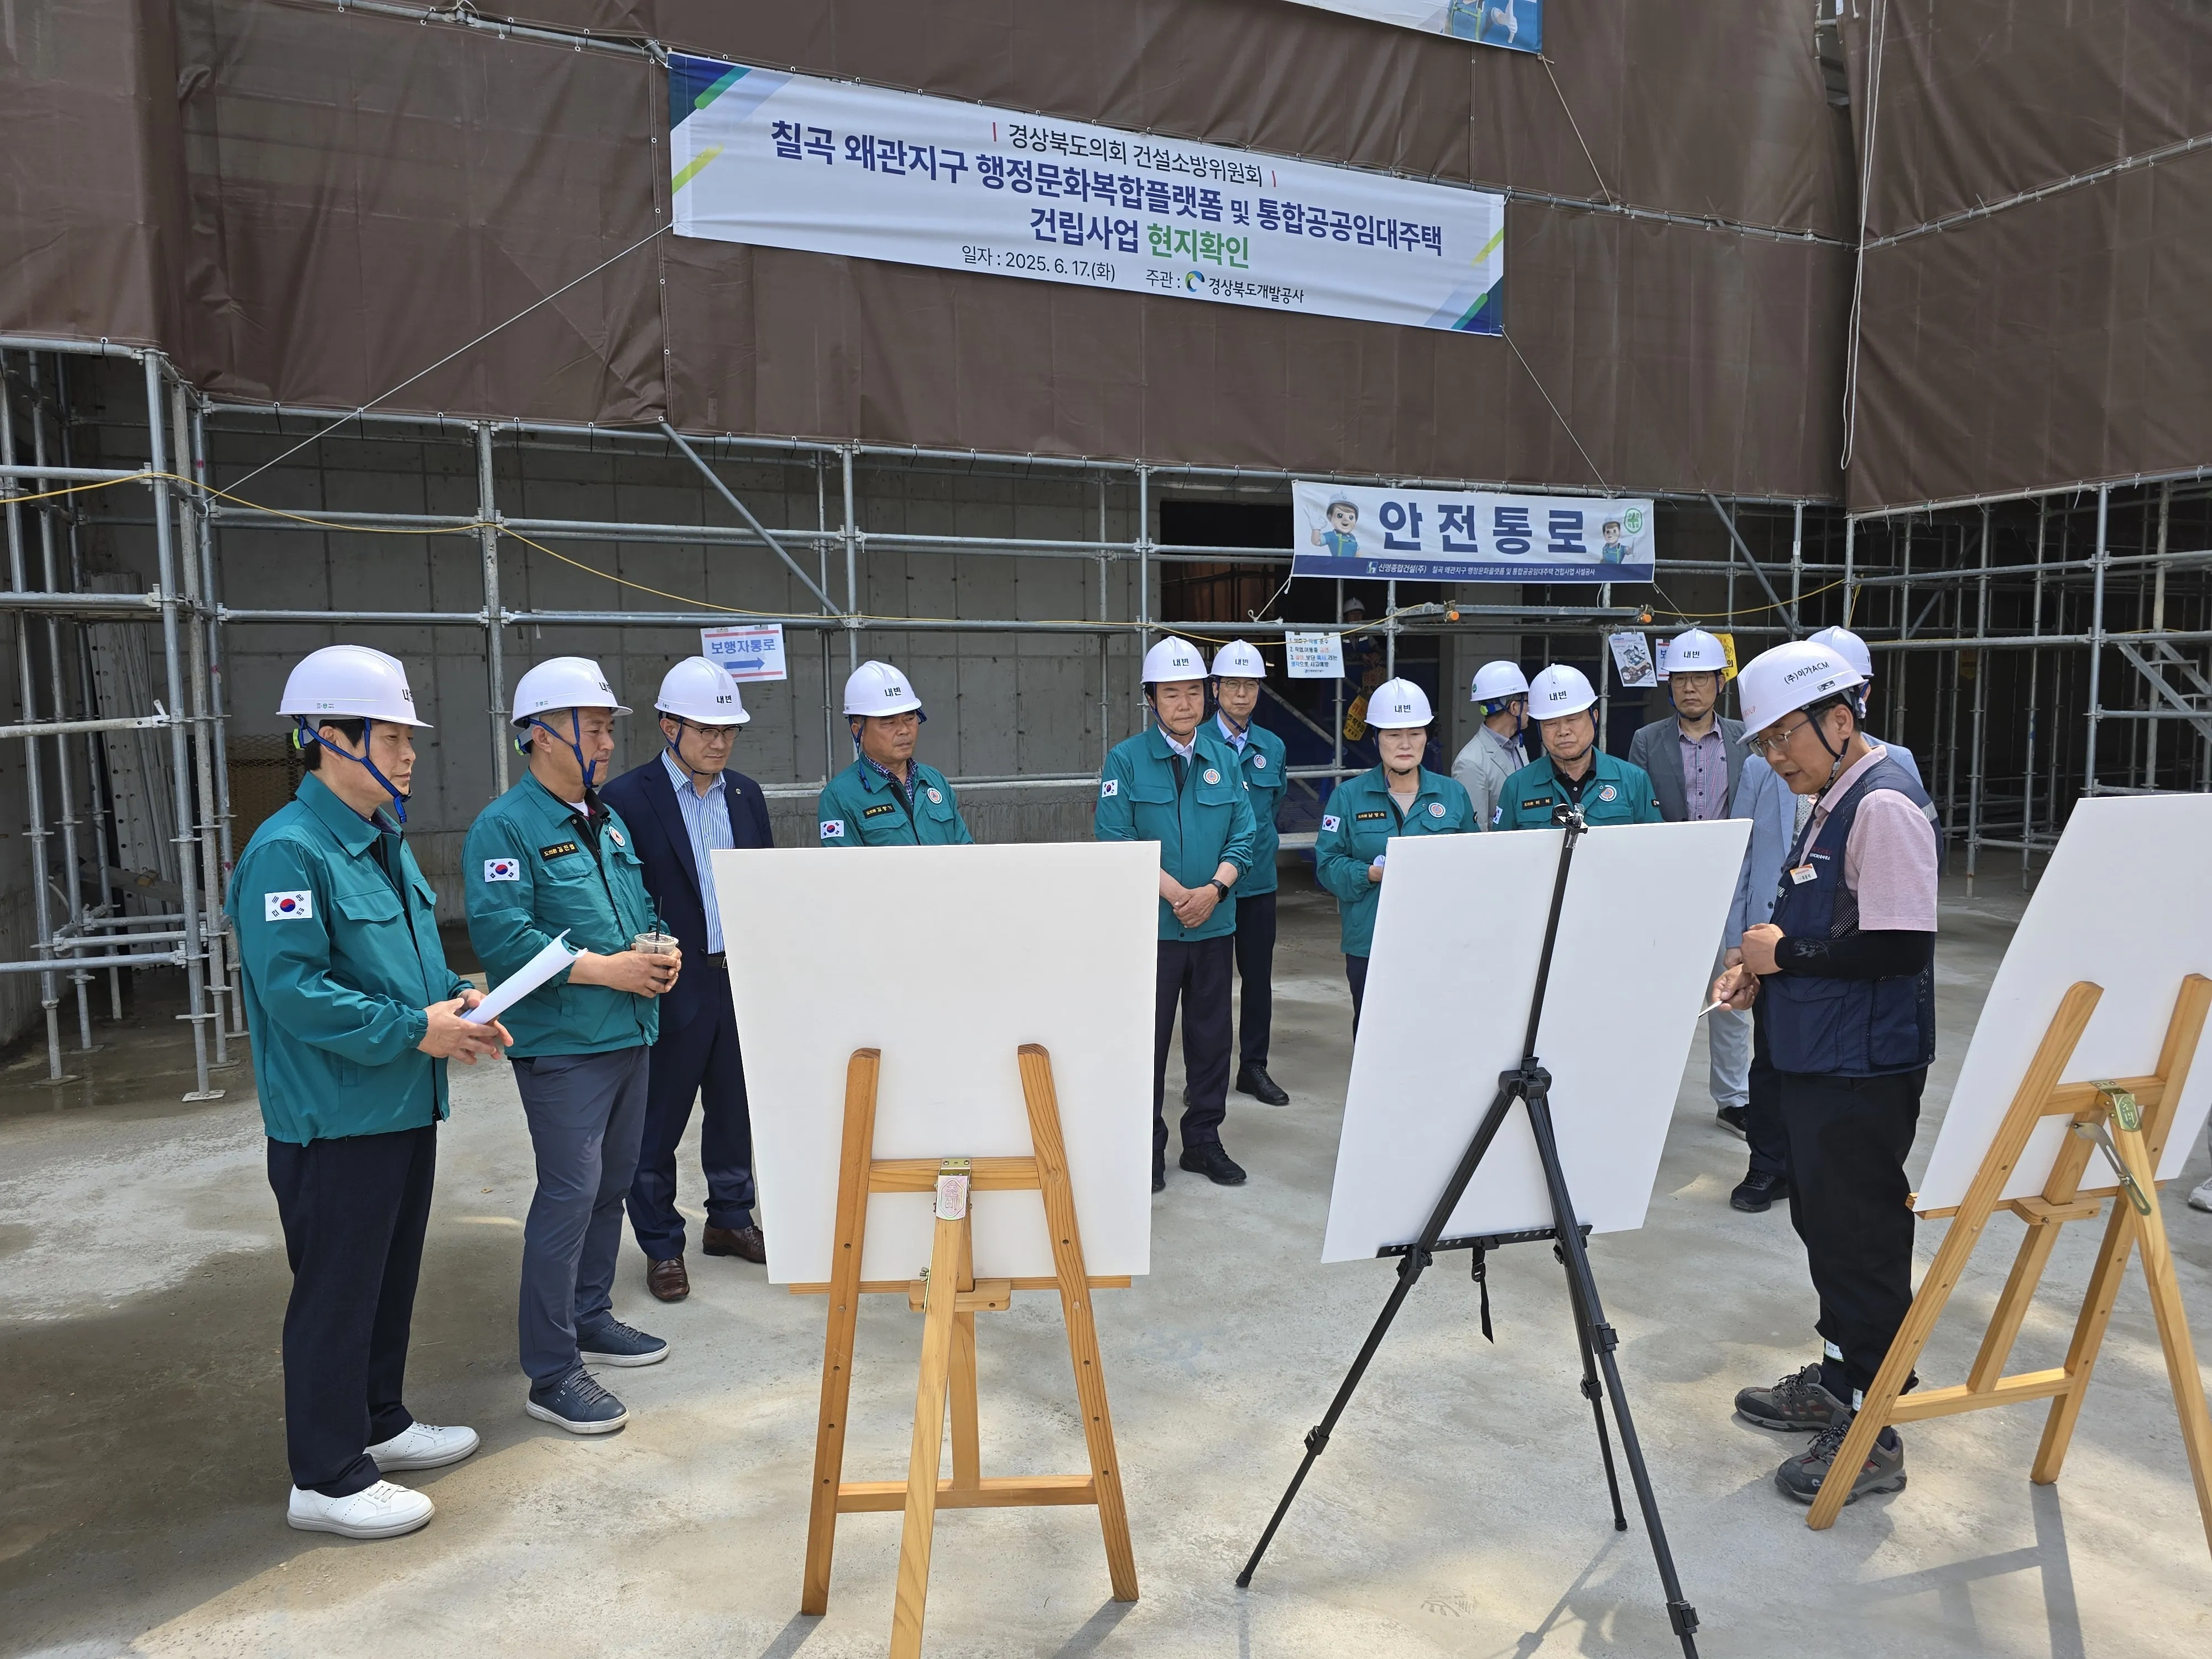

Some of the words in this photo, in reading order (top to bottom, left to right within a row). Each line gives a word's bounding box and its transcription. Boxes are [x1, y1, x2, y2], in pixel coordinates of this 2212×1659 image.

[1008, 123, 1126, 166] 경상북도의회
[1133, 145, 1263, 187] 건설소방위원회
[771, 120, 836, 165] 칠곡
[844, 133, 968, 184] 왜관지구
[976, 154, 1223, 223] 행정문화복합플랫폼
[1230, 199, 1250, 227] 및
[1256, 198, 1443, 257] 통합공공임대주택
[1030, 208, 1139, 254] 건립사업
[1147, 223, 1250, 269] 현지확인
[961, 245, 994, 267] 일자
[1005, 252, 1050, 273] 2025.
[1053, 258, 1068, 275] 6.
[1072, 260, 1115, 283] 17.(화)
[1145, 269, 1174, 289] 주관
[1208, 276, 1305, 305] 경상북도개발공사
[1379, 500, 1587, 555] 안전통로
[1378, 563, 1427, 574] 신명종합건설(주)
[1432, 566, 1443, 574] 칠곡
[1444, 566, 1467, 575] 왜관지구
[711, 639, 776, 655] 보행자통로
[1172, 658, 1190, 667] 내빈
[1235, 658, 1249, 666] 내빈
[884, 686, 902, 697] 내빈
[1549, 690, 1567, 701] 내빈
[716, 695, 732, 704] 내빈
[1394, 704, 1411, 713] 내빈
